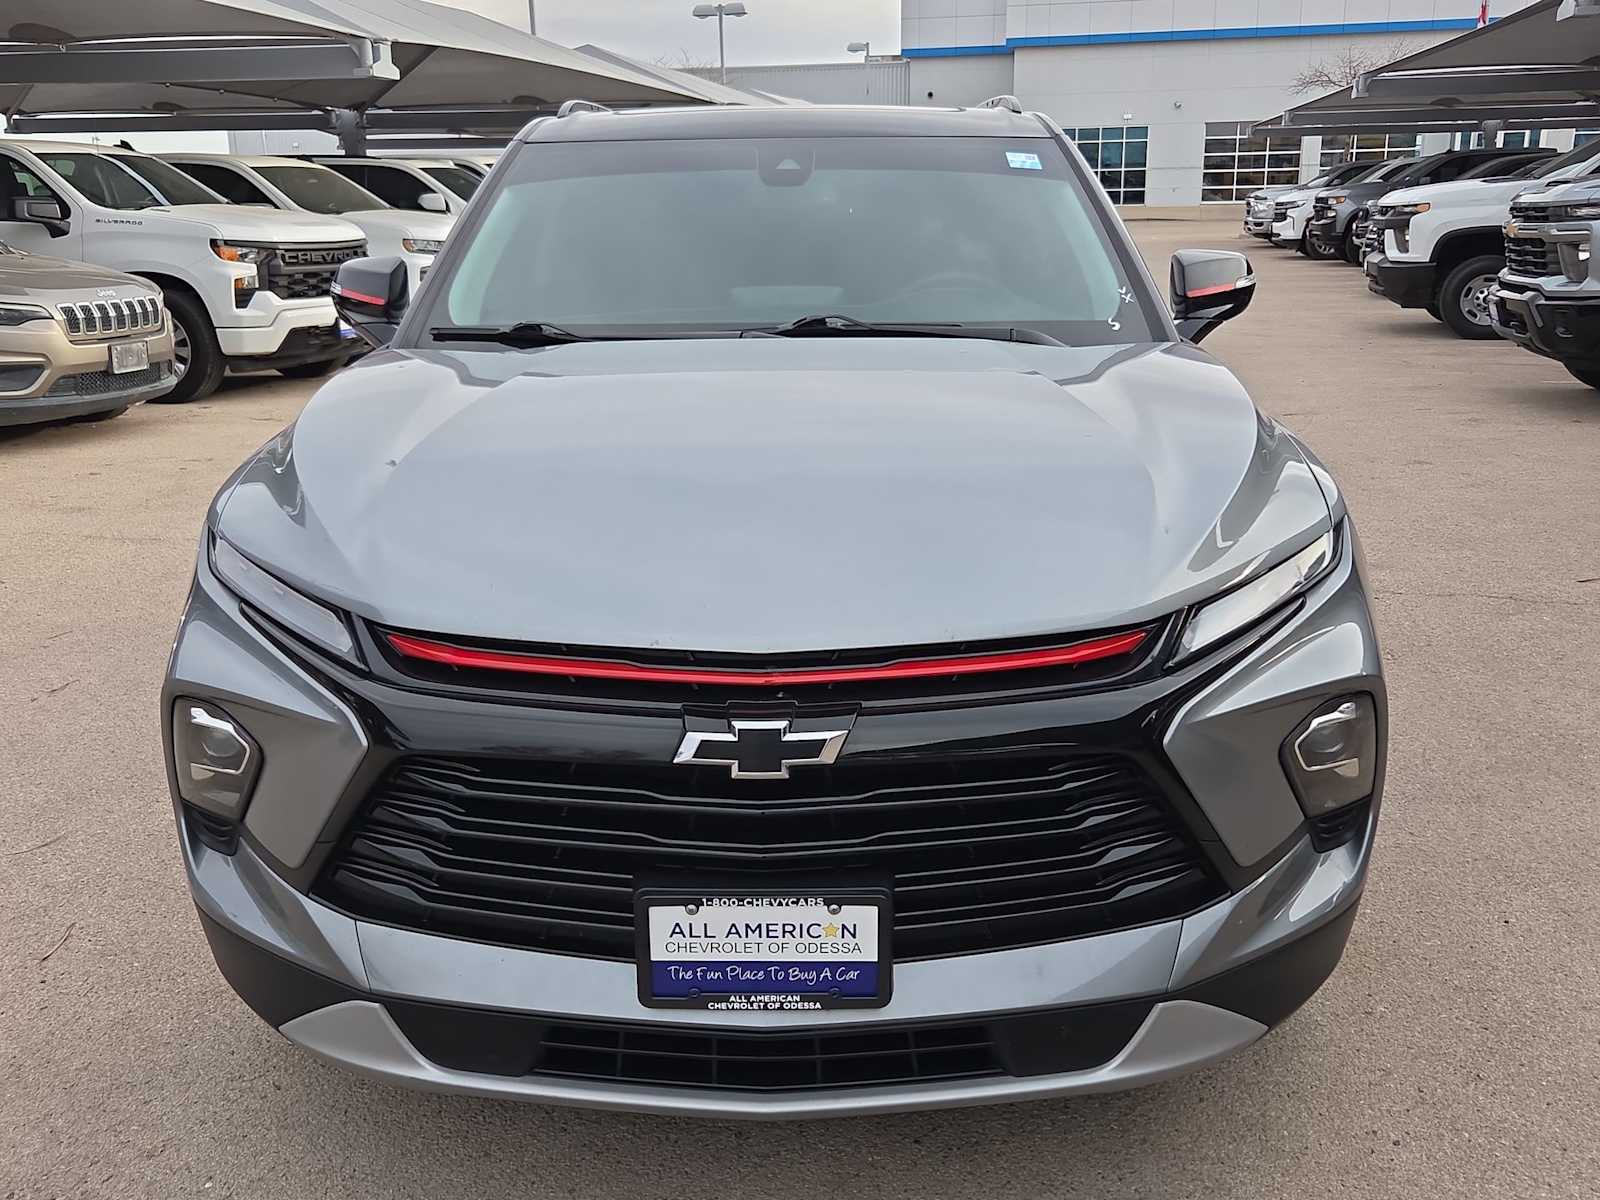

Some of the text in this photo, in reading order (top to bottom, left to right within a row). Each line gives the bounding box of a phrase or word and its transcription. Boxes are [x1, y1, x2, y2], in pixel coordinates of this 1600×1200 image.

[702, 897, 825, 907] 1-800-CHEVYCARS
[669, 922, 716, 938] ALL
[665, 942, 862, 954] CHEVROLET OF ODESSA
[667, 965, 860, 985] The Fun Place To Buy A Car
[708, 1002, 822, 1010] CHEVROLET OF ODESSA
